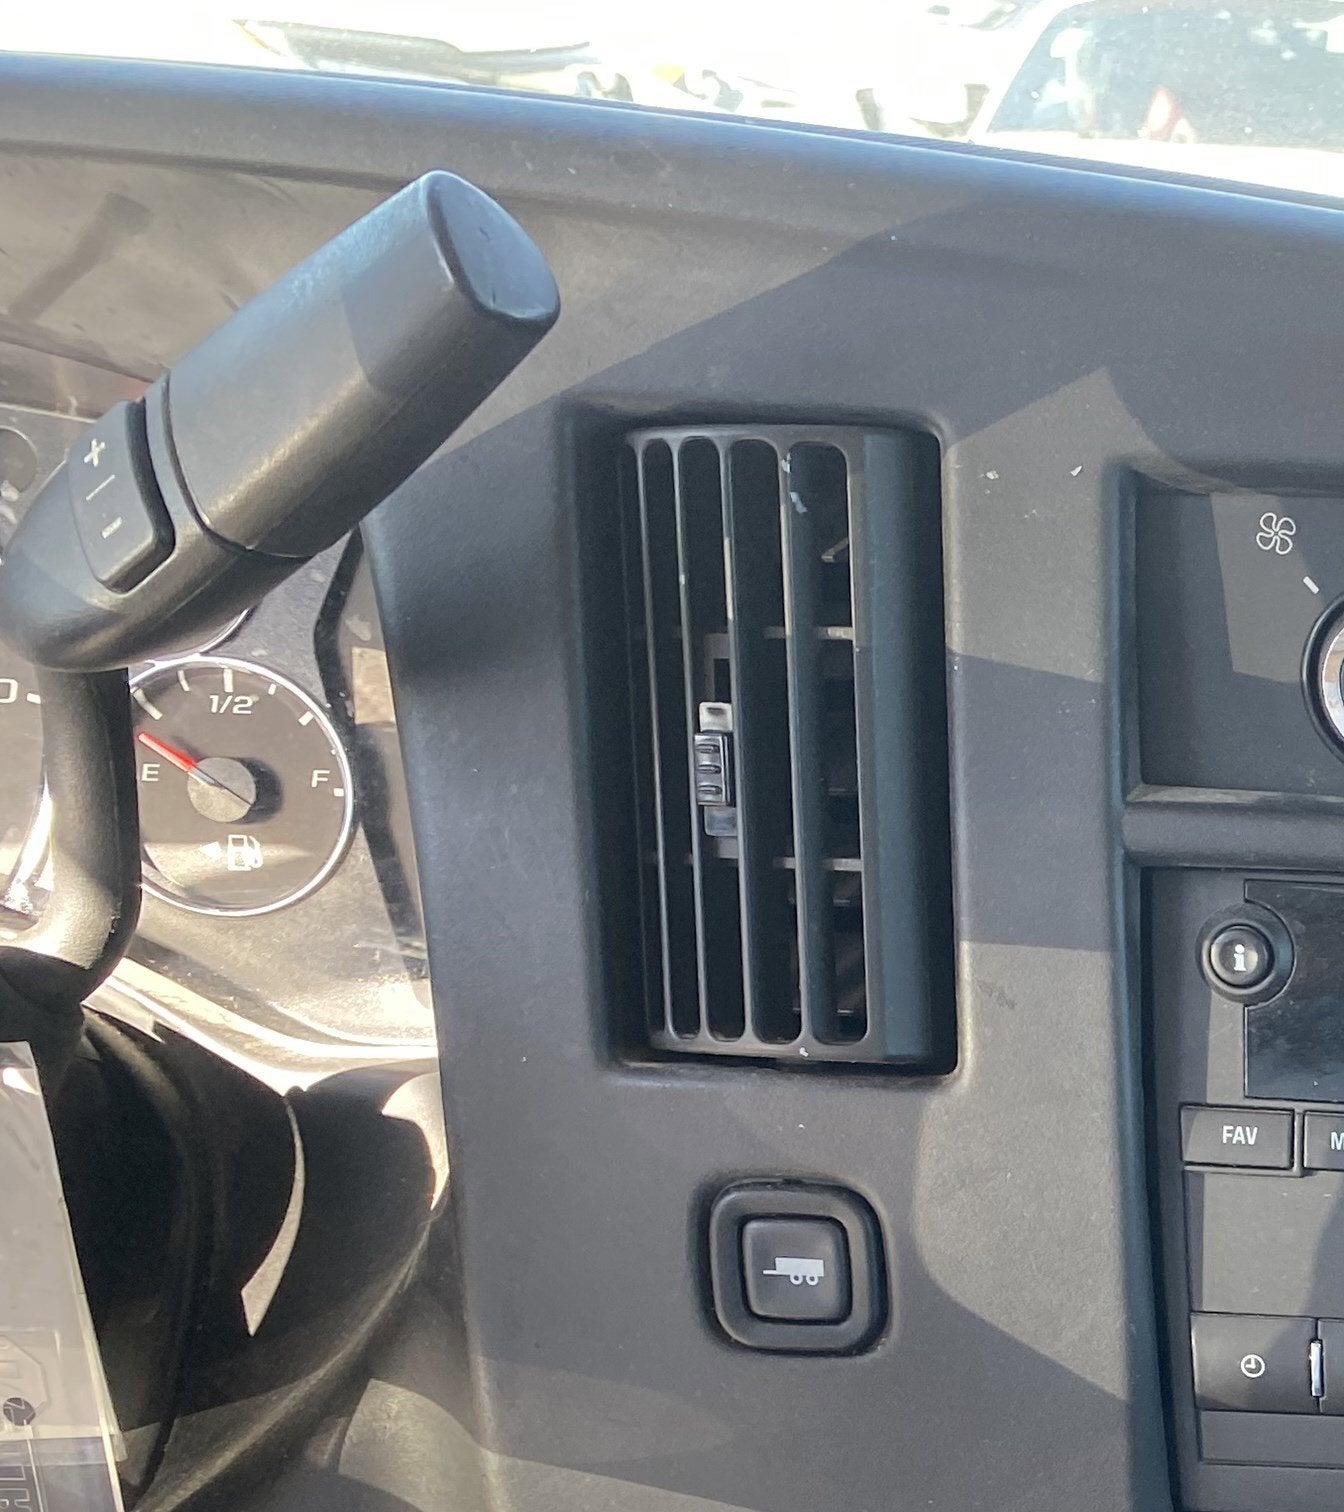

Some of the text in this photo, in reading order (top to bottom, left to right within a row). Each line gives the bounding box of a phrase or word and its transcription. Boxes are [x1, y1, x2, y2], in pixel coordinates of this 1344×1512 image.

[208, 694, 254, 716] 1/2
[142, 763, 161, 783] E
[311, 770, 330, 788] F
[1221, 1125, 1259, 1146] FAV
